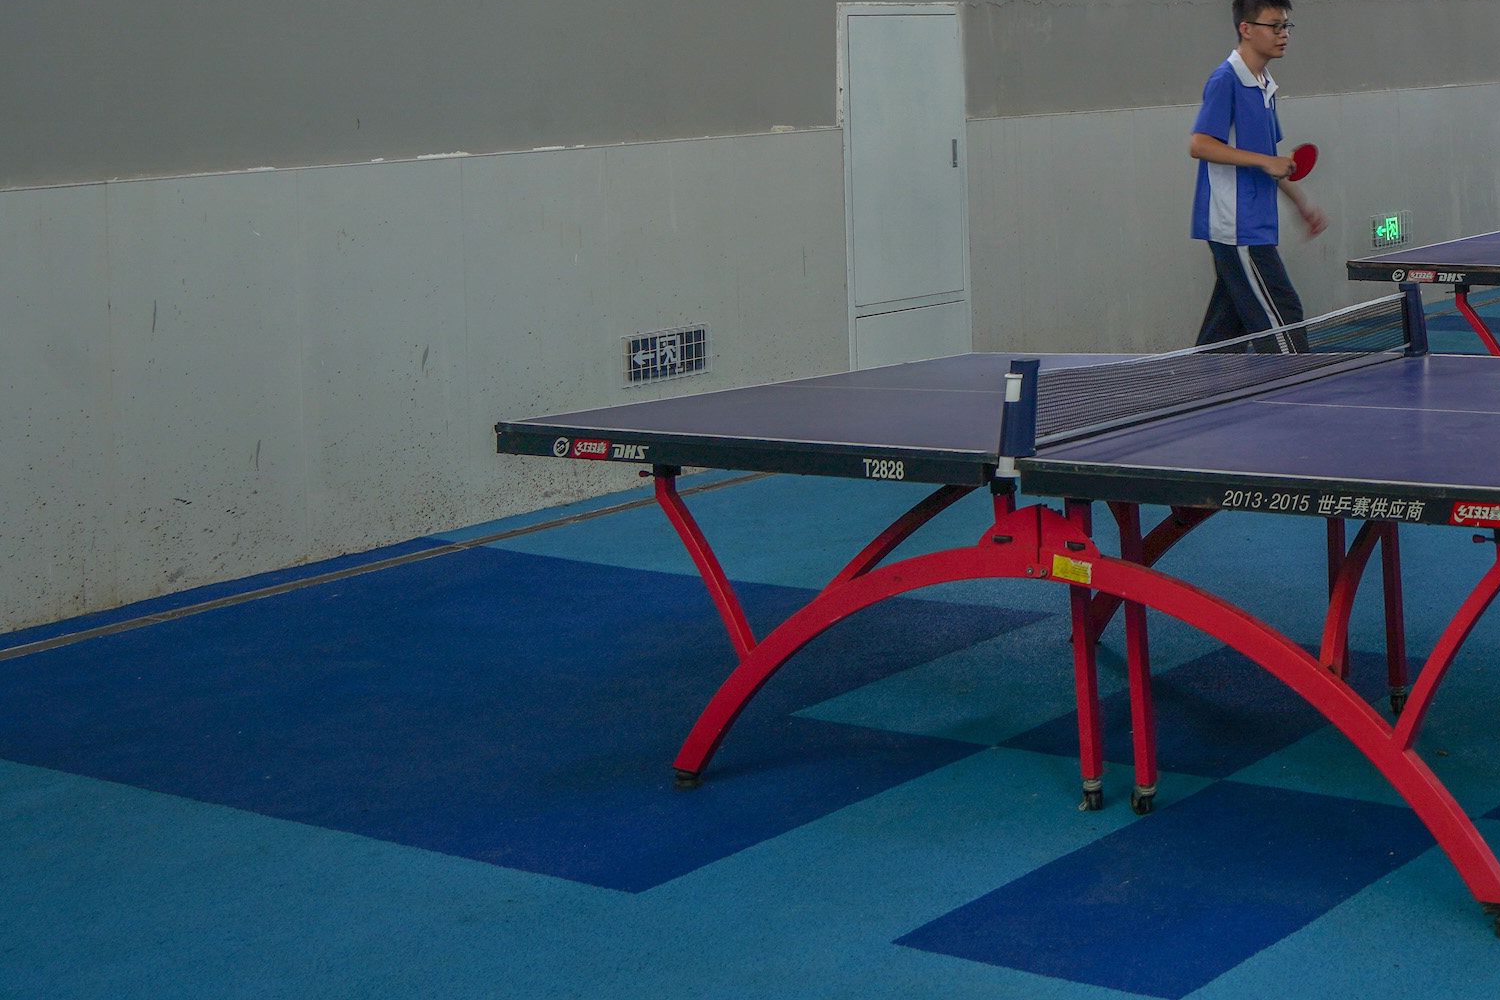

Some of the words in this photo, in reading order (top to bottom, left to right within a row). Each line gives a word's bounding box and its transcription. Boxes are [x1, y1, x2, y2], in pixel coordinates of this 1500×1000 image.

[1437, 272, 1466, 283] DHS
[574, 441, 607, 456] 红双喜
[612, 443, 650, 460] DHS
[862, 458, 905, 480] T2828
[1317, 494, 1426, 522] 世乒赛供应商
